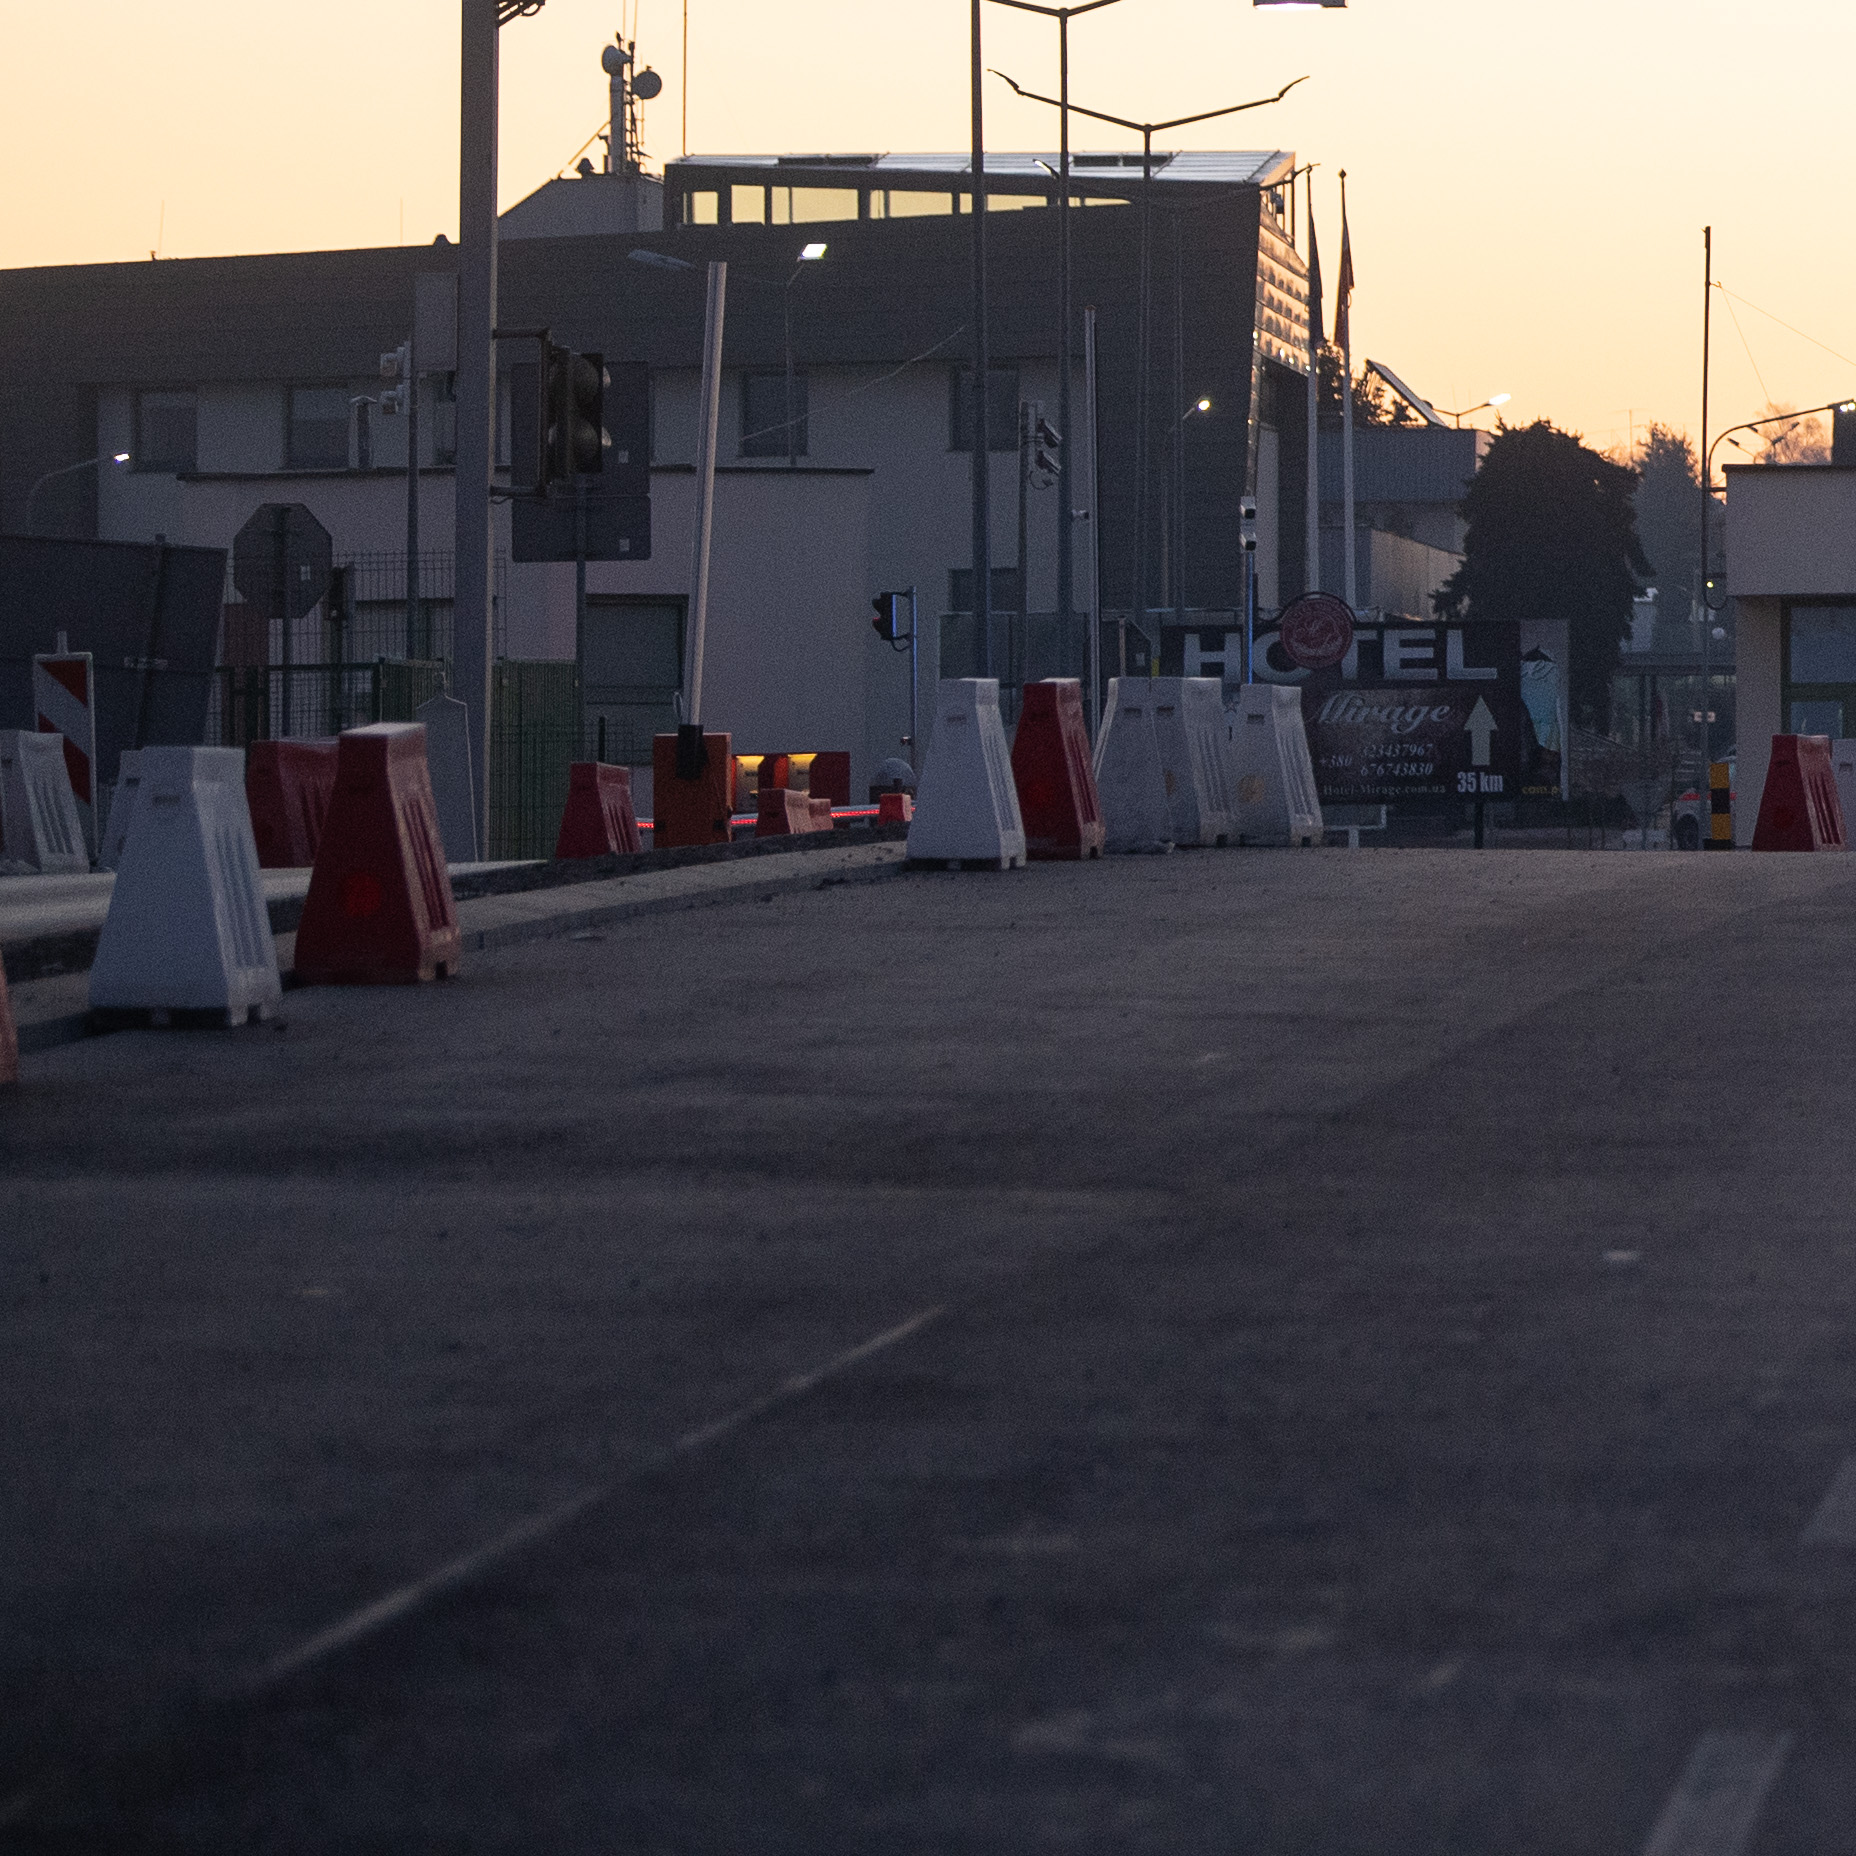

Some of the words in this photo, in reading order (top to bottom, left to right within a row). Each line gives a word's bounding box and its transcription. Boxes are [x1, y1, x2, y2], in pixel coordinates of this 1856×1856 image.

[1310, 693, 1451, 735] Mirage
[1360, 761, 1434, 777] 676743830
[1457, 771, 1477, 793] 35
[1479, 771, 1504, 793] km
